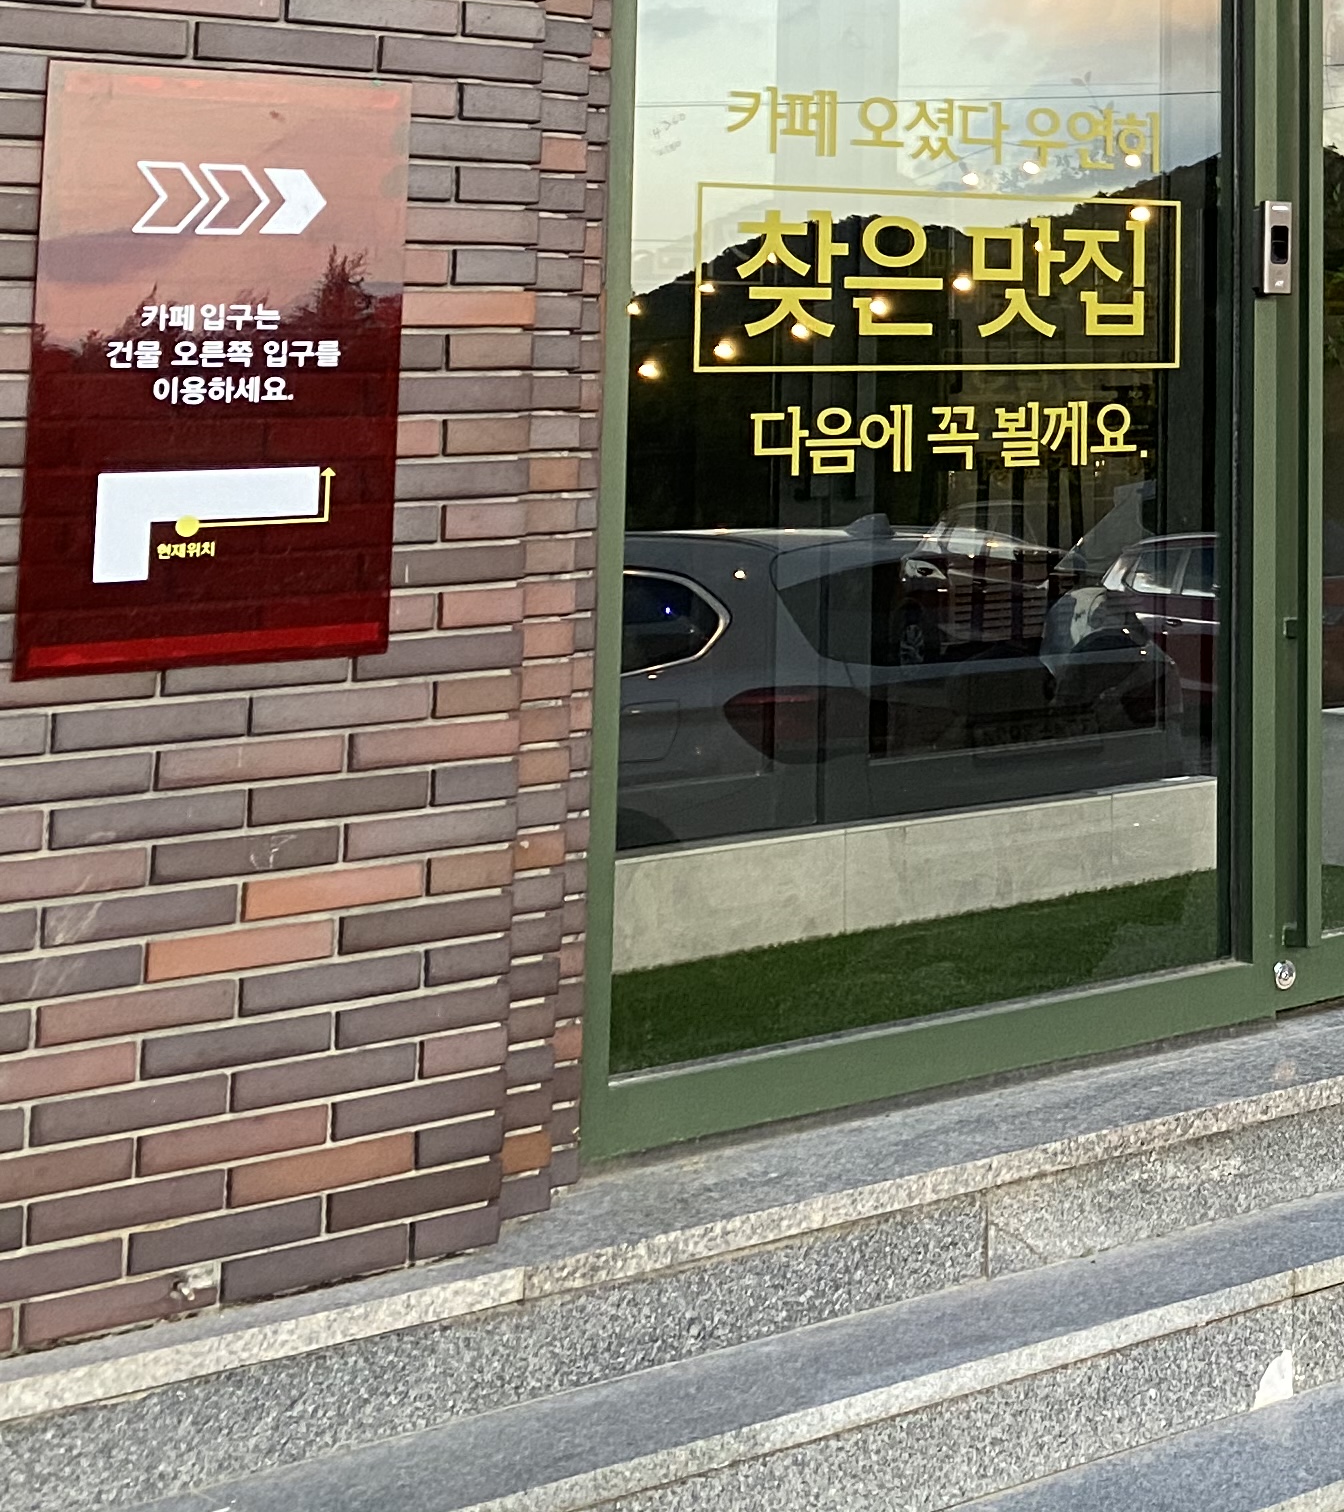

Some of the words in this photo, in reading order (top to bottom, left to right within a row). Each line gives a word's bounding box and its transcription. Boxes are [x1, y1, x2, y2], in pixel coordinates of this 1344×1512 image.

[727, 87, 837, 157] 카페
[851, 96, 1009, 165] 오셨다
[1018, 108, 1160, 173] 우연히
[737, 210, 943, 338] 찾은
[966, 217, 1146, 338] 맛집
[141, 304, 195, 331] 카페
[200, 304, 281, 331] 입구는
[106, 340, 162, 368] 건물
[171, 340, 253, 368] 오른쪽
[263, 340, 341, 368] 입구를
[153, 376, 294, 405] 이용하세요.
[751, 405, 912, 476] 다음에
[928, 406, 979, 470] 꼭
[992, 401, 1148, 468] 뵐께요.
[157, 541, 215, 559] 현재위치
